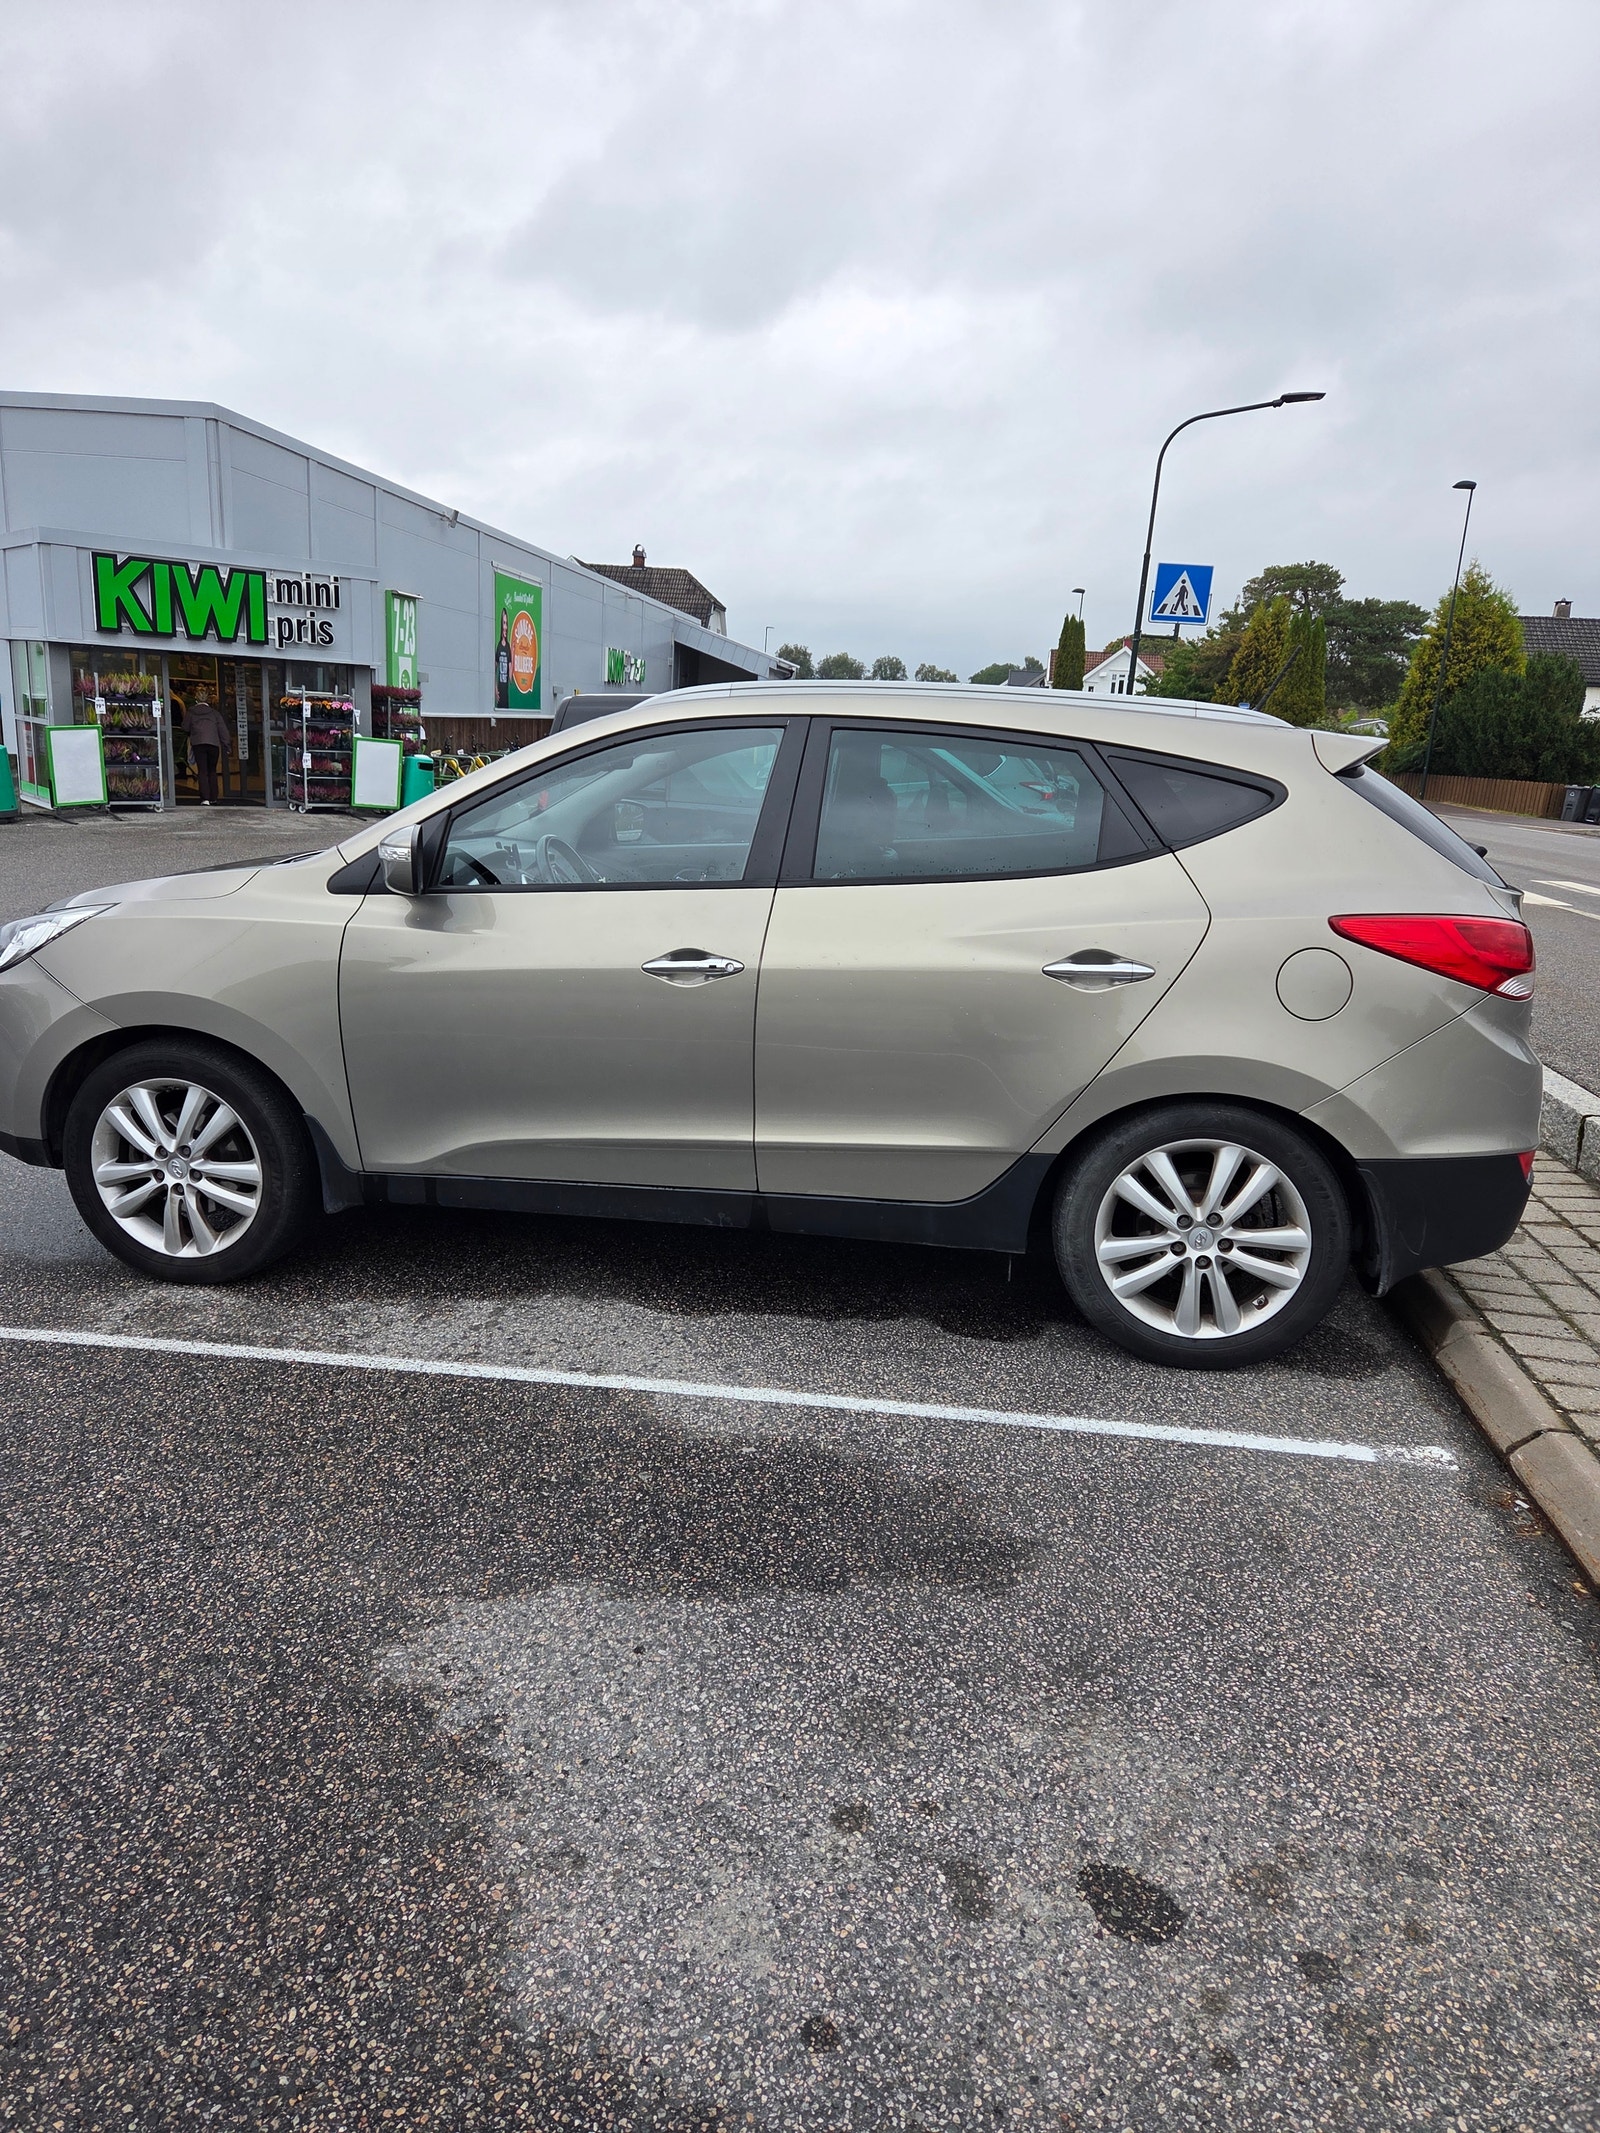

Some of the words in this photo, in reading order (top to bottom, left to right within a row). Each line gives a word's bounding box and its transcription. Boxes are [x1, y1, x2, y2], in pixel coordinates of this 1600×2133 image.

[91, 551, 269, 645] KIWI
[274, 572, 341, 609] mini
[275, 610, 335, 649] pris
[393, 598, 416, 656] 7-23
